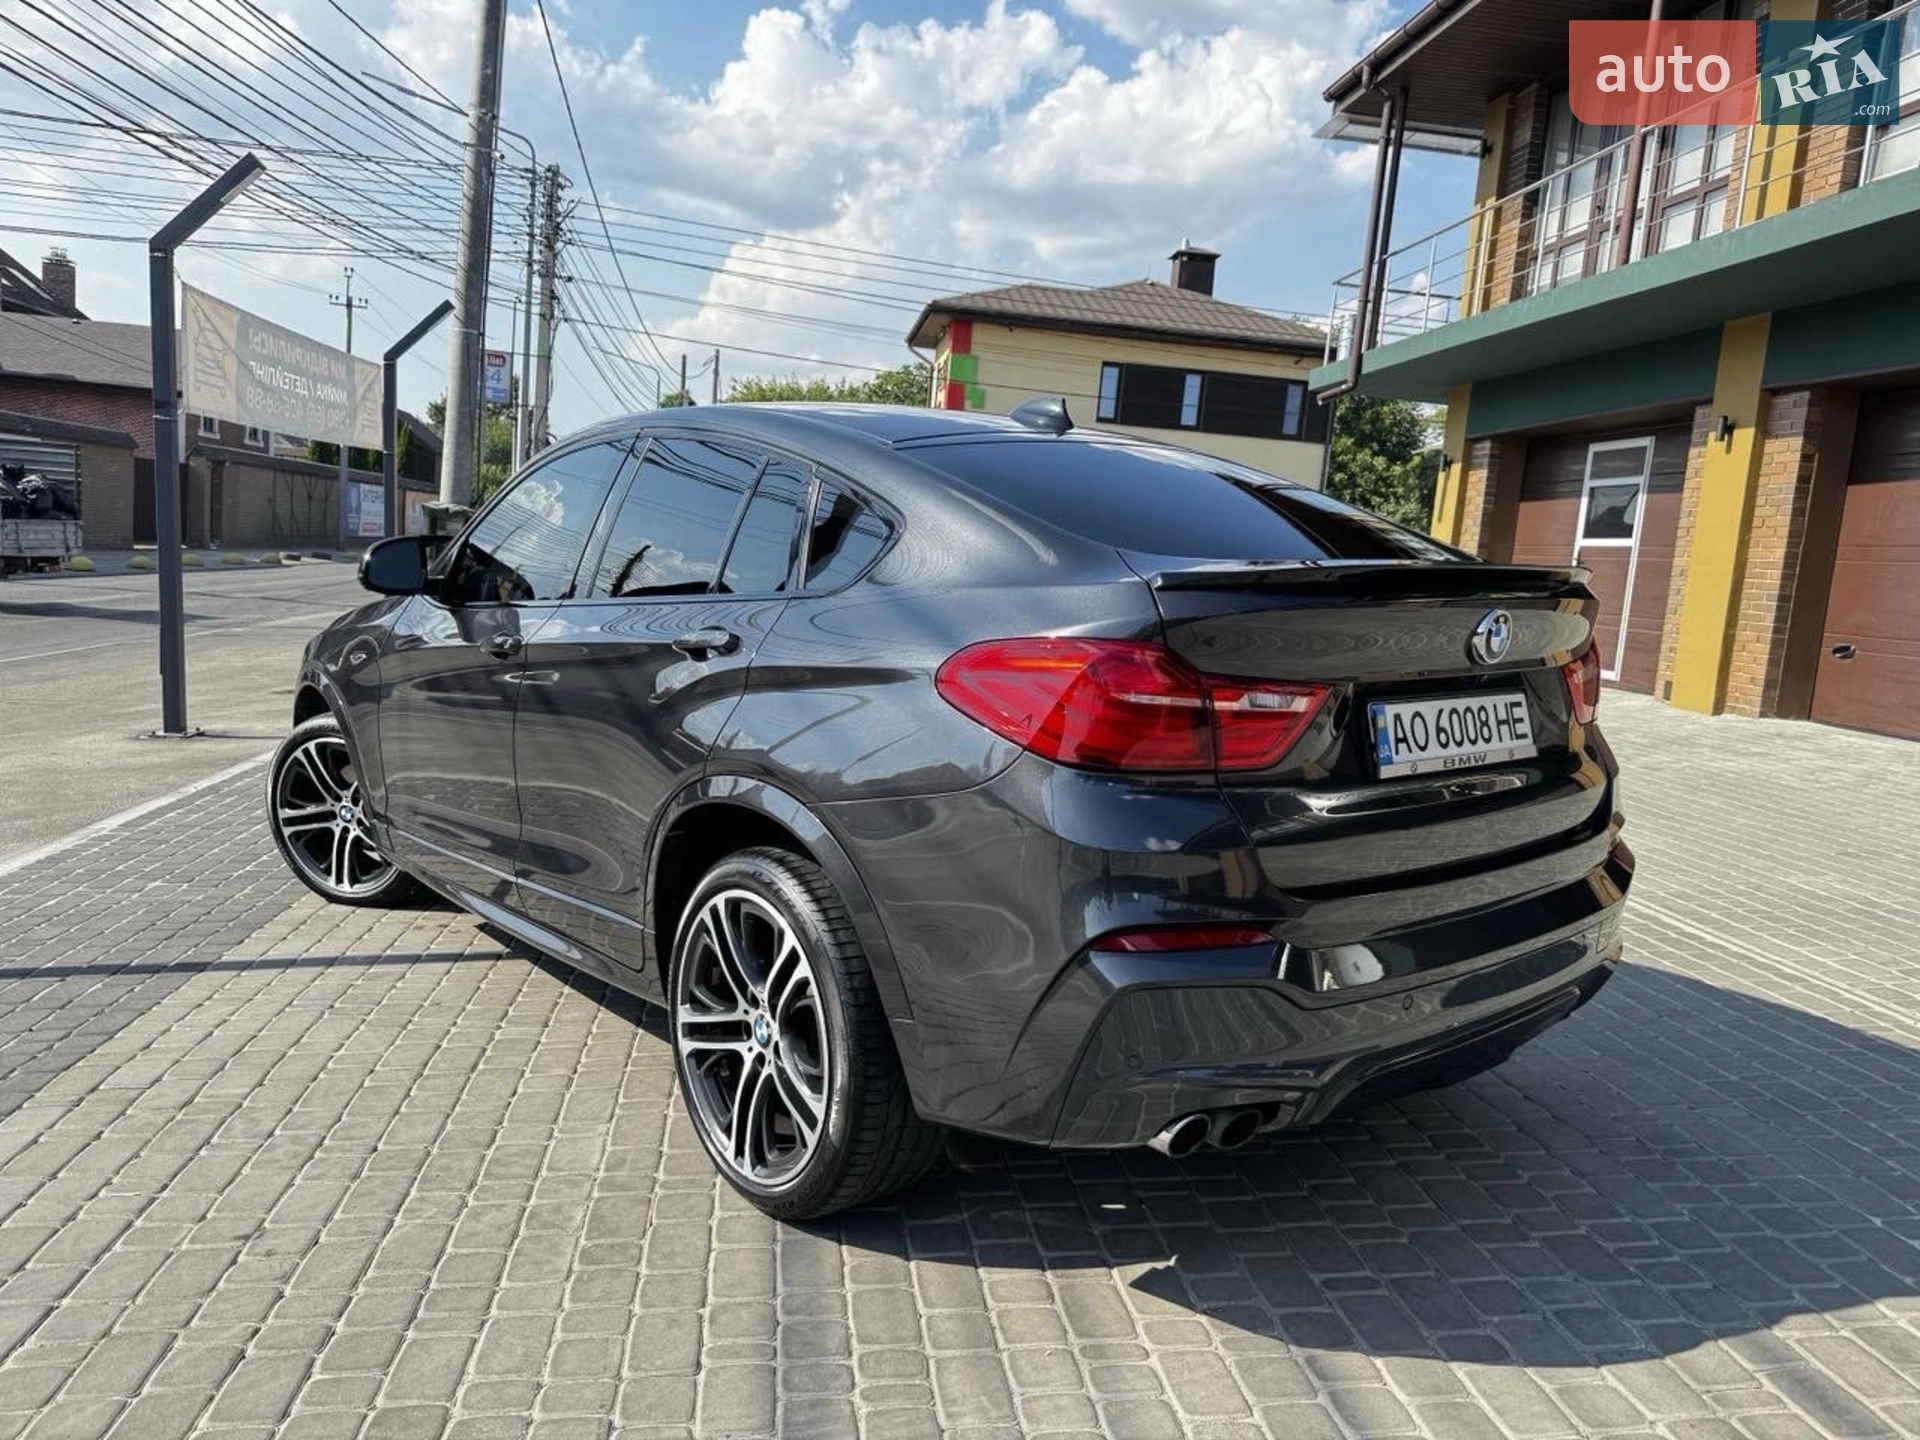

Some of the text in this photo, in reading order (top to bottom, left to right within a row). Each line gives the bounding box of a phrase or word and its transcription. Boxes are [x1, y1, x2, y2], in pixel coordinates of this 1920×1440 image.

[1392, 701, 1529, 756] AO 6008 HE
[1443, 753, 1488, 769] BMW
